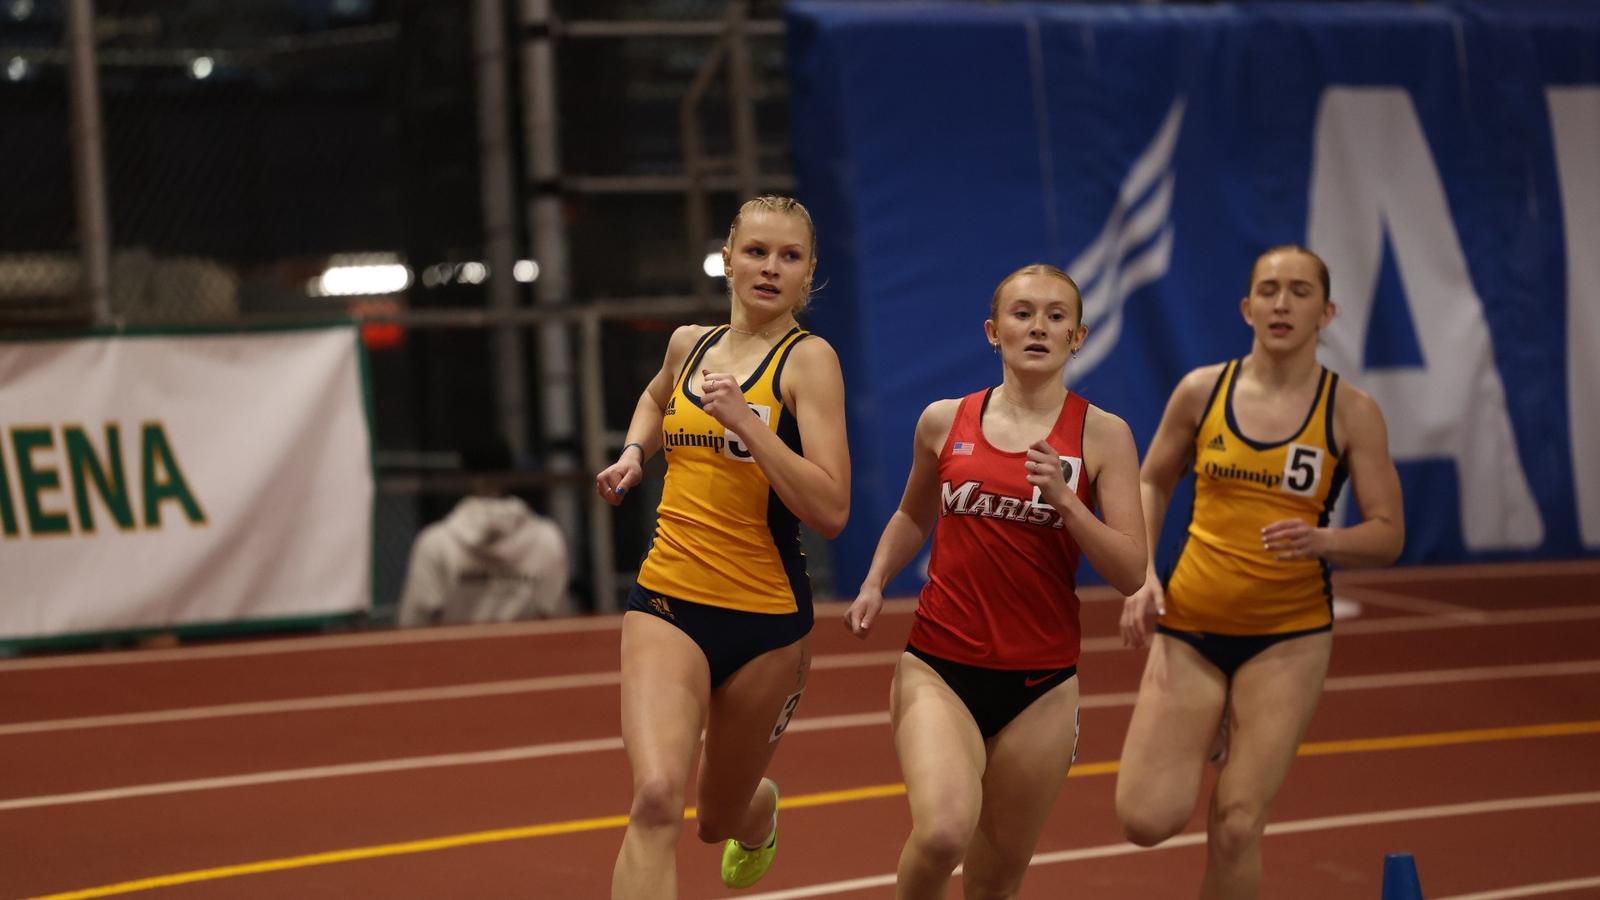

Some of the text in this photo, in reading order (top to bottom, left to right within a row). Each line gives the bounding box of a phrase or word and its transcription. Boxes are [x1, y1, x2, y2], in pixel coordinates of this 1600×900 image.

[1305, 86, 1600, 549] A
[1205, 463, 1280, 488] Quinnip
[1288, 448, 1316, 491] 5
[775, 693, 801, 737] 3
